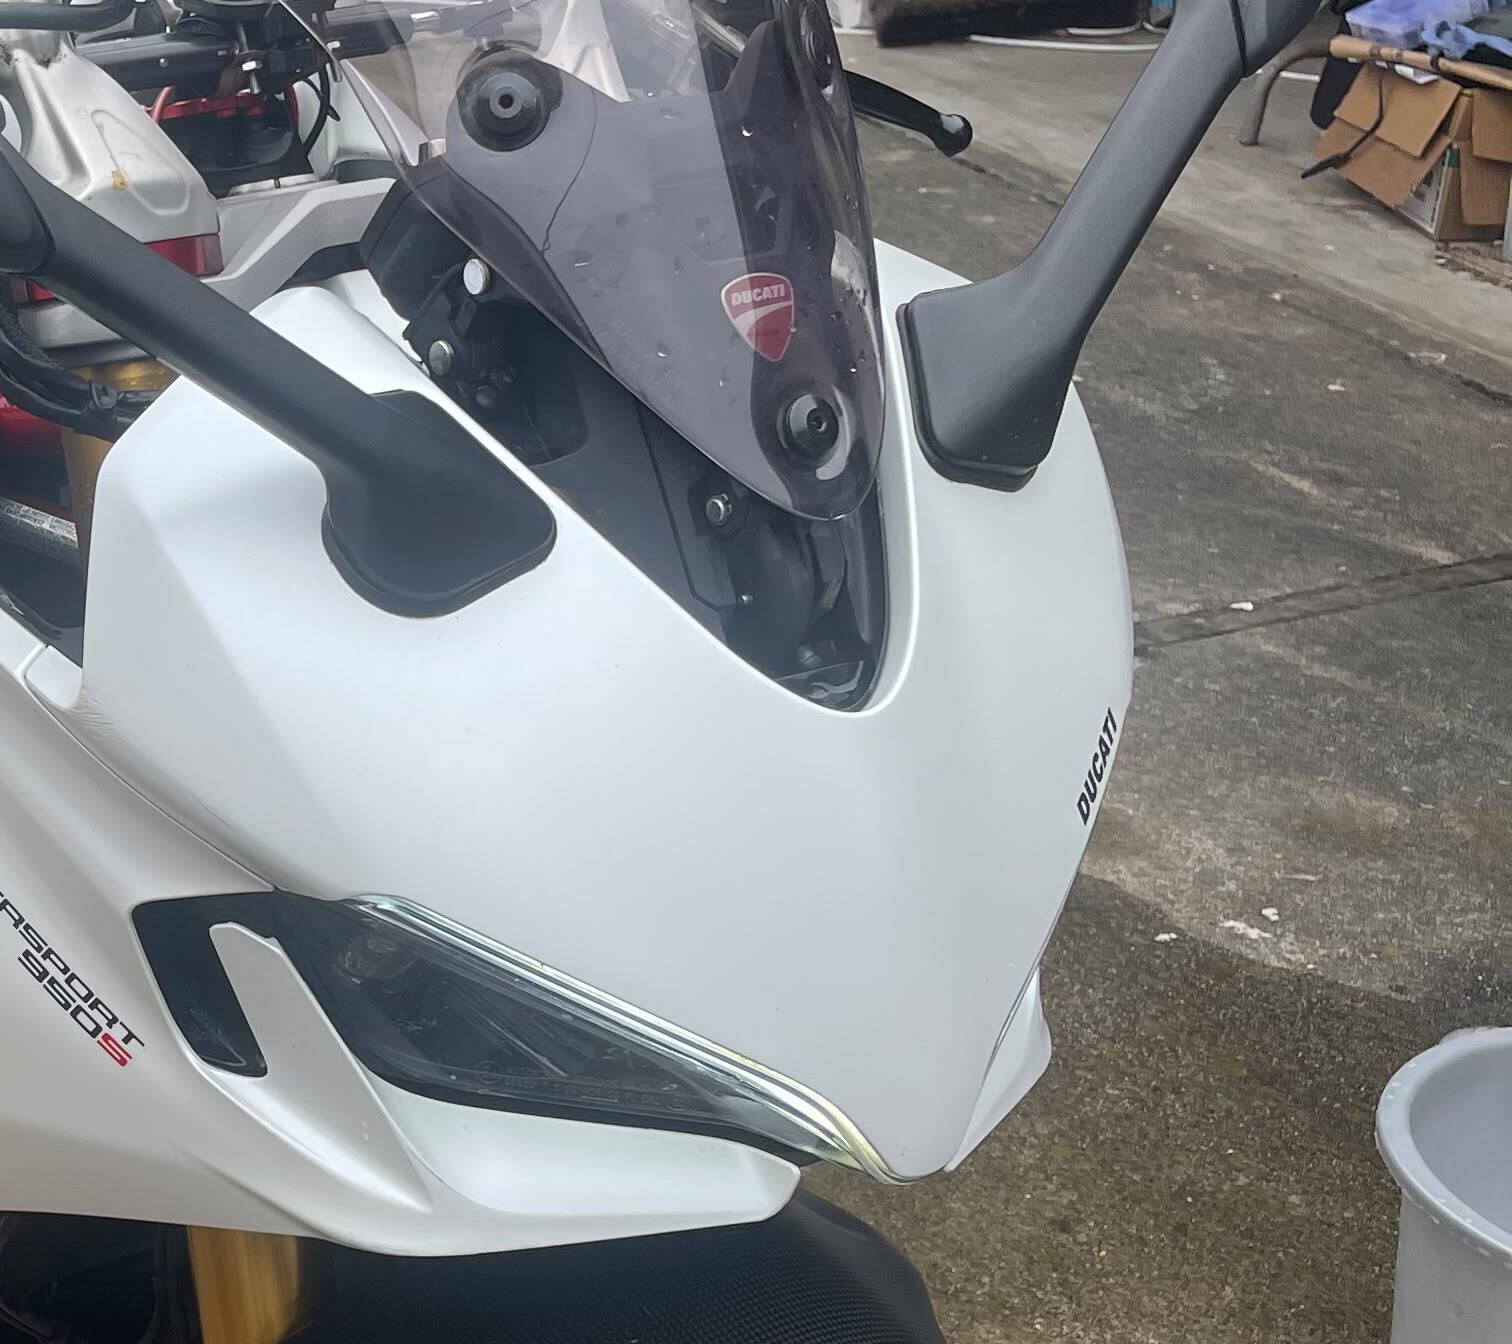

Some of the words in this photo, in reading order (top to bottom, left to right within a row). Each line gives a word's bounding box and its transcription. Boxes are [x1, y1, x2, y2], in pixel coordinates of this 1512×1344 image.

[730, 283, 786, 307] DUCATI
[1076, 706, 1117, 827] DUCATI
[16, 948, 133, 1068] 950S
